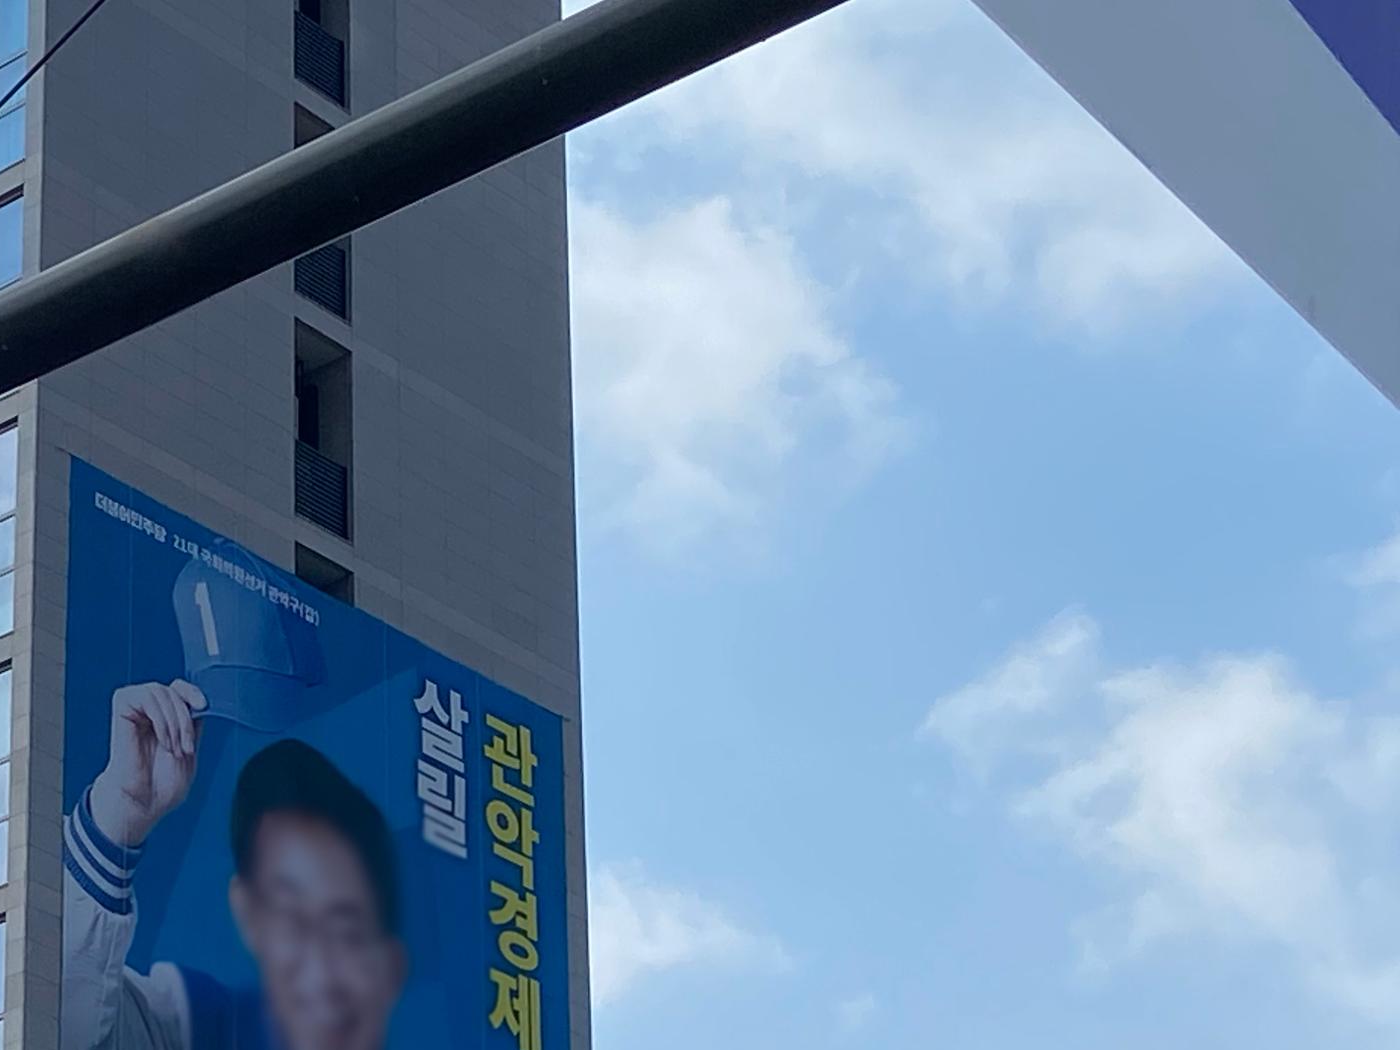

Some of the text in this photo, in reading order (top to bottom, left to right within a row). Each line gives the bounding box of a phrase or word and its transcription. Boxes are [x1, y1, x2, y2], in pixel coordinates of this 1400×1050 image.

[94, 491, 167, 543] 더불어민주당
[173, 534, 200, 560] 21대
[200, 547, 267, 597] 국회의원선거
[194, 581, 220, 657] 1
[413, 678, 469, 860] 살릴
